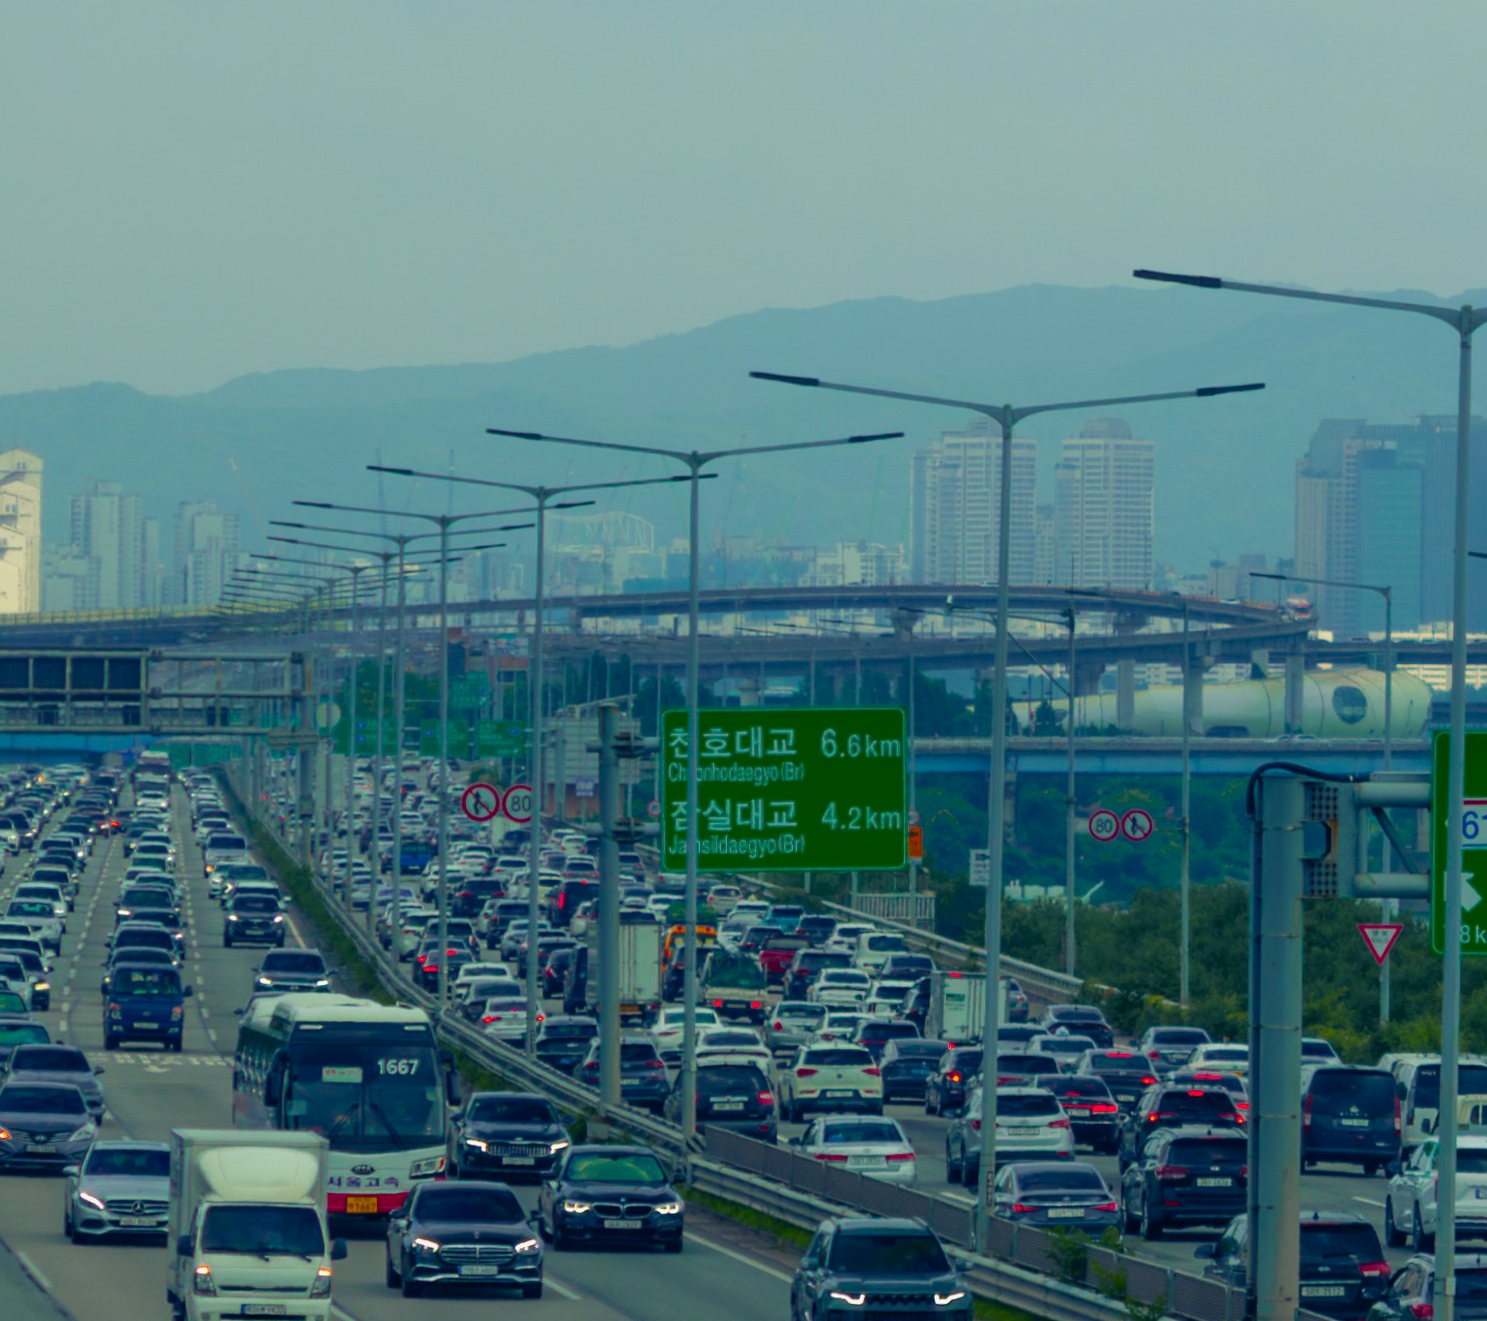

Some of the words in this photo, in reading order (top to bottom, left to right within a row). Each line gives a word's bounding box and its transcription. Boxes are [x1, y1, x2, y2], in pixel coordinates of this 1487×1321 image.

[668, 762, 805, 786] Chonhodaegyo(Br)
[511, 796, 531, 812] 80
[1095, 818, 1113, 834] 80
[377, 1059, 419, 1075] 1667
